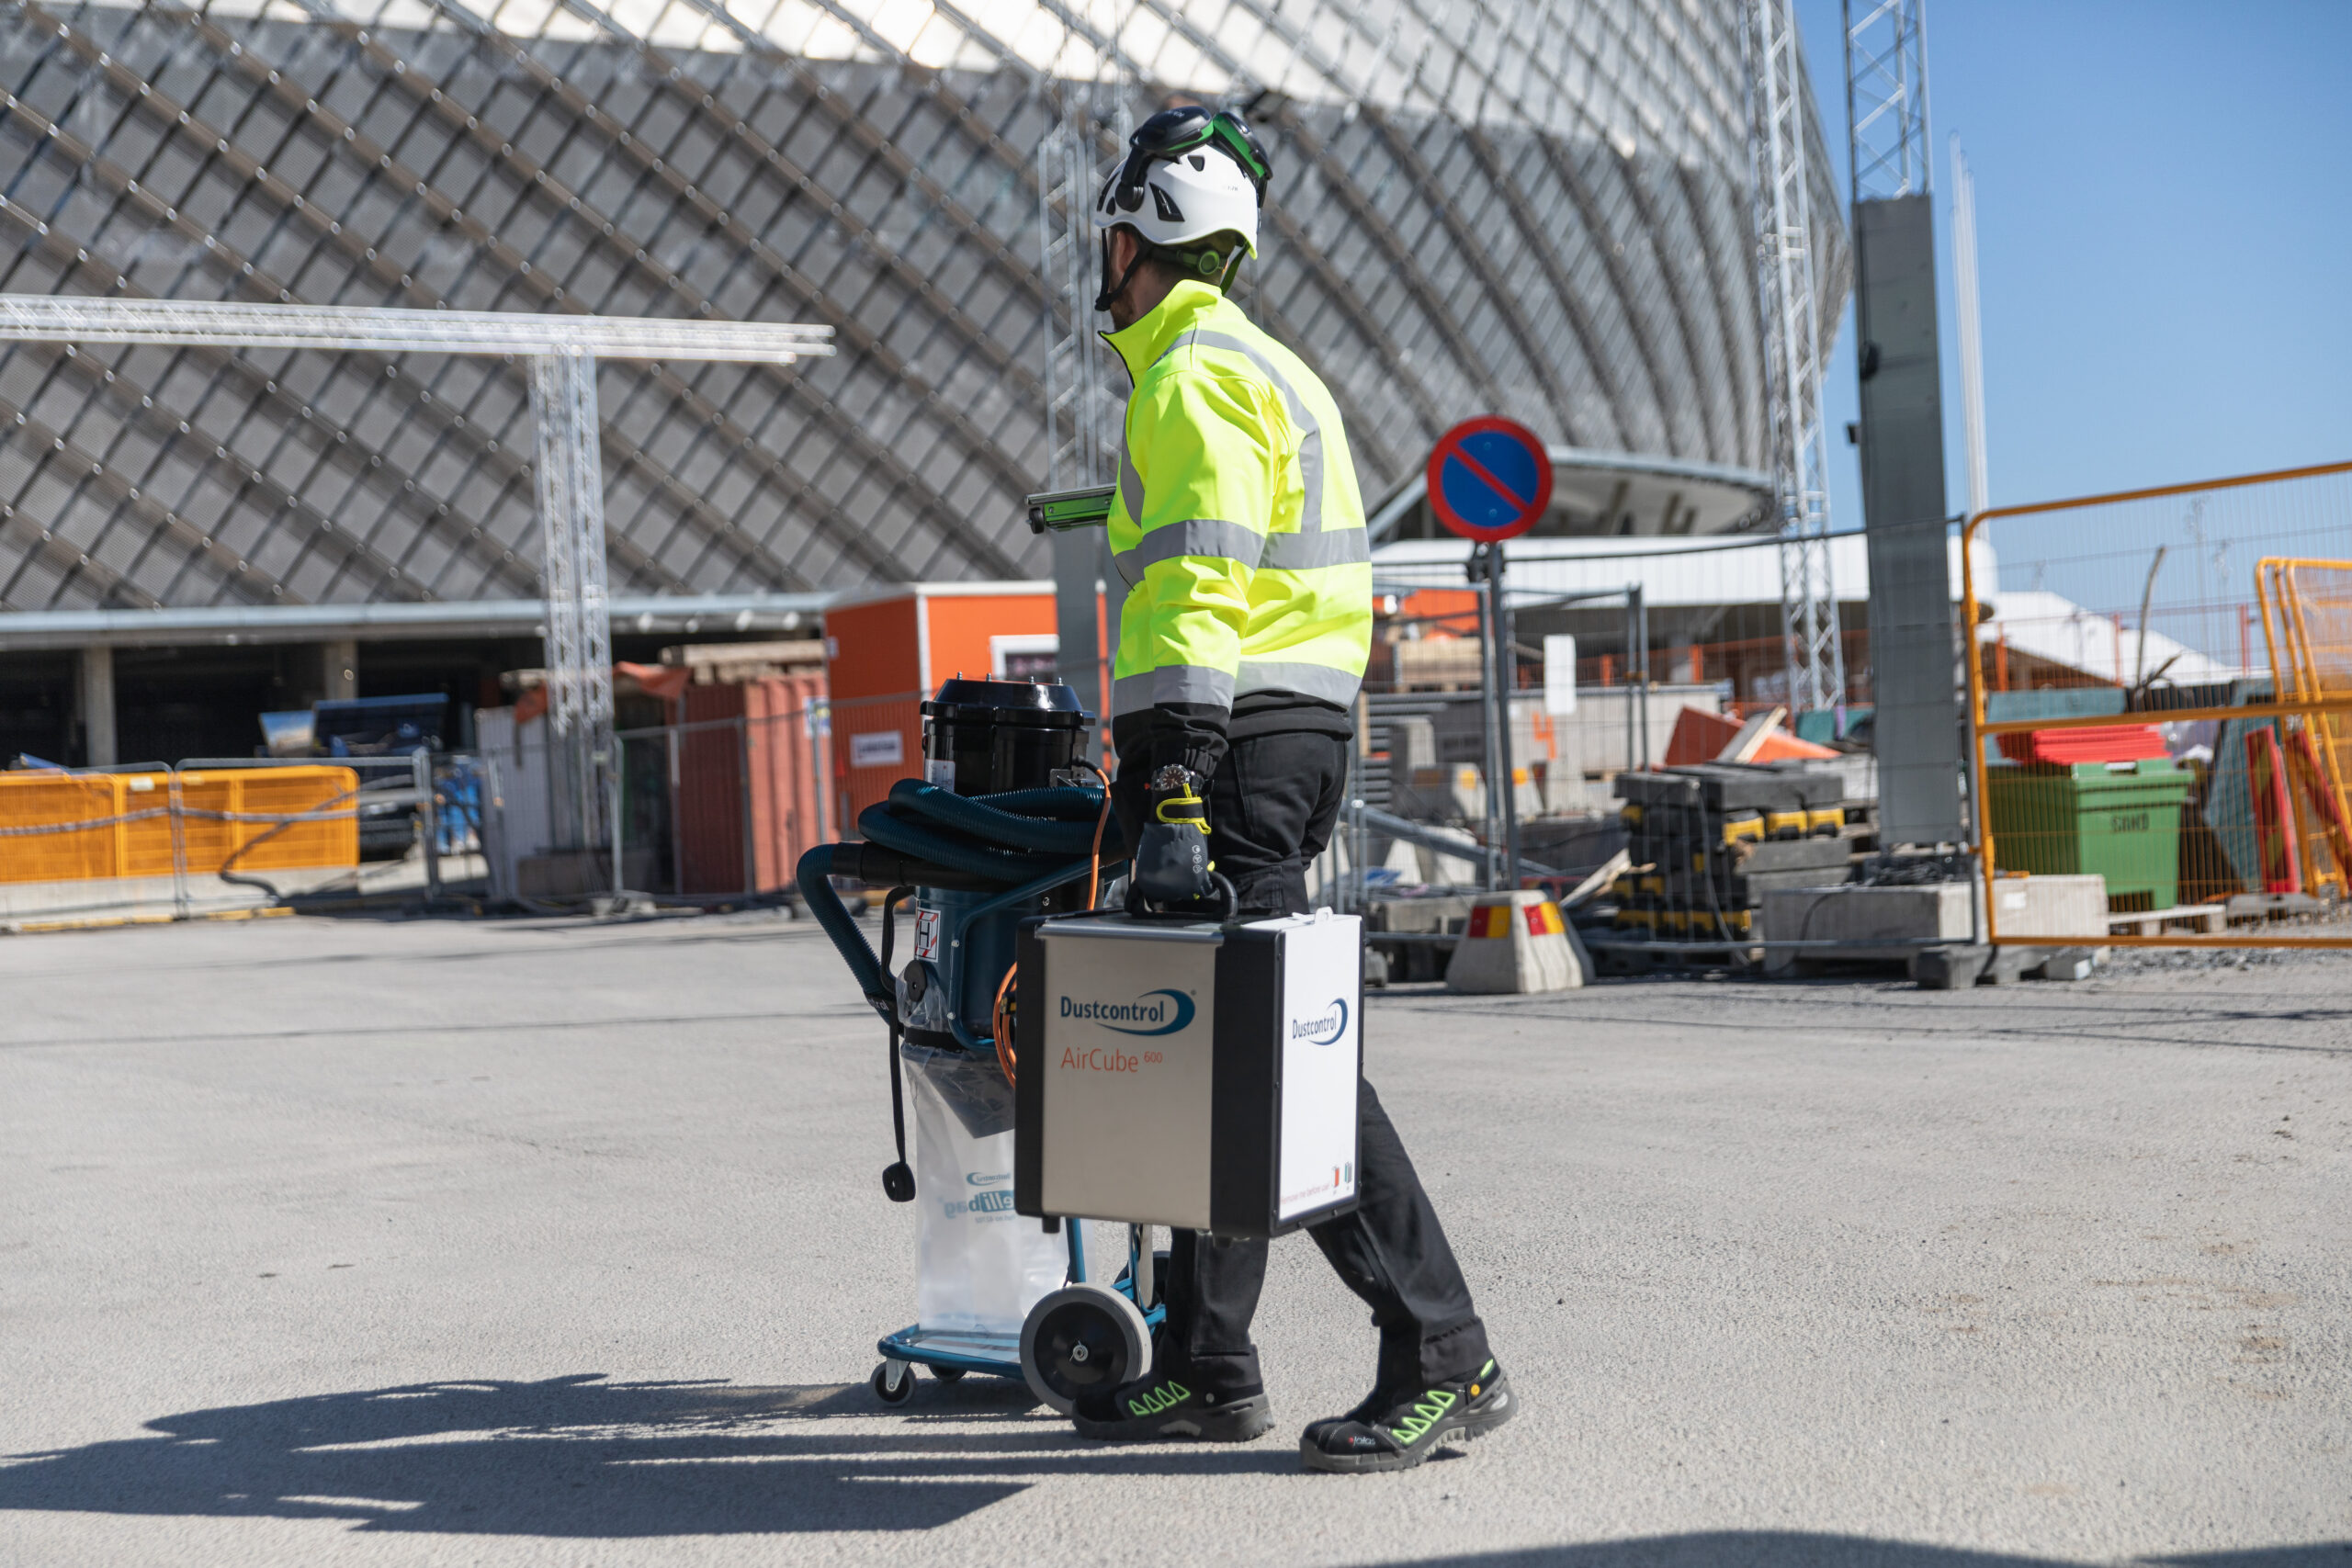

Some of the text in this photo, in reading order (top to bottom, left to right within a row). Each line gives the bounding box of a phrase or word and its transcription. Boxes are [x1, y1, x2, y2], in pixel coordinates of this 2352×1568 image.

[1532, 710, 1558, 761] 4
[919, 920, 931, 948] H
[1060, 995, 1165, 1022] Dustcontrol
[1292, 1010, 1338, 1040] Dustcontrol
[1060, 1046, 1164, 1073] AirCube 600
